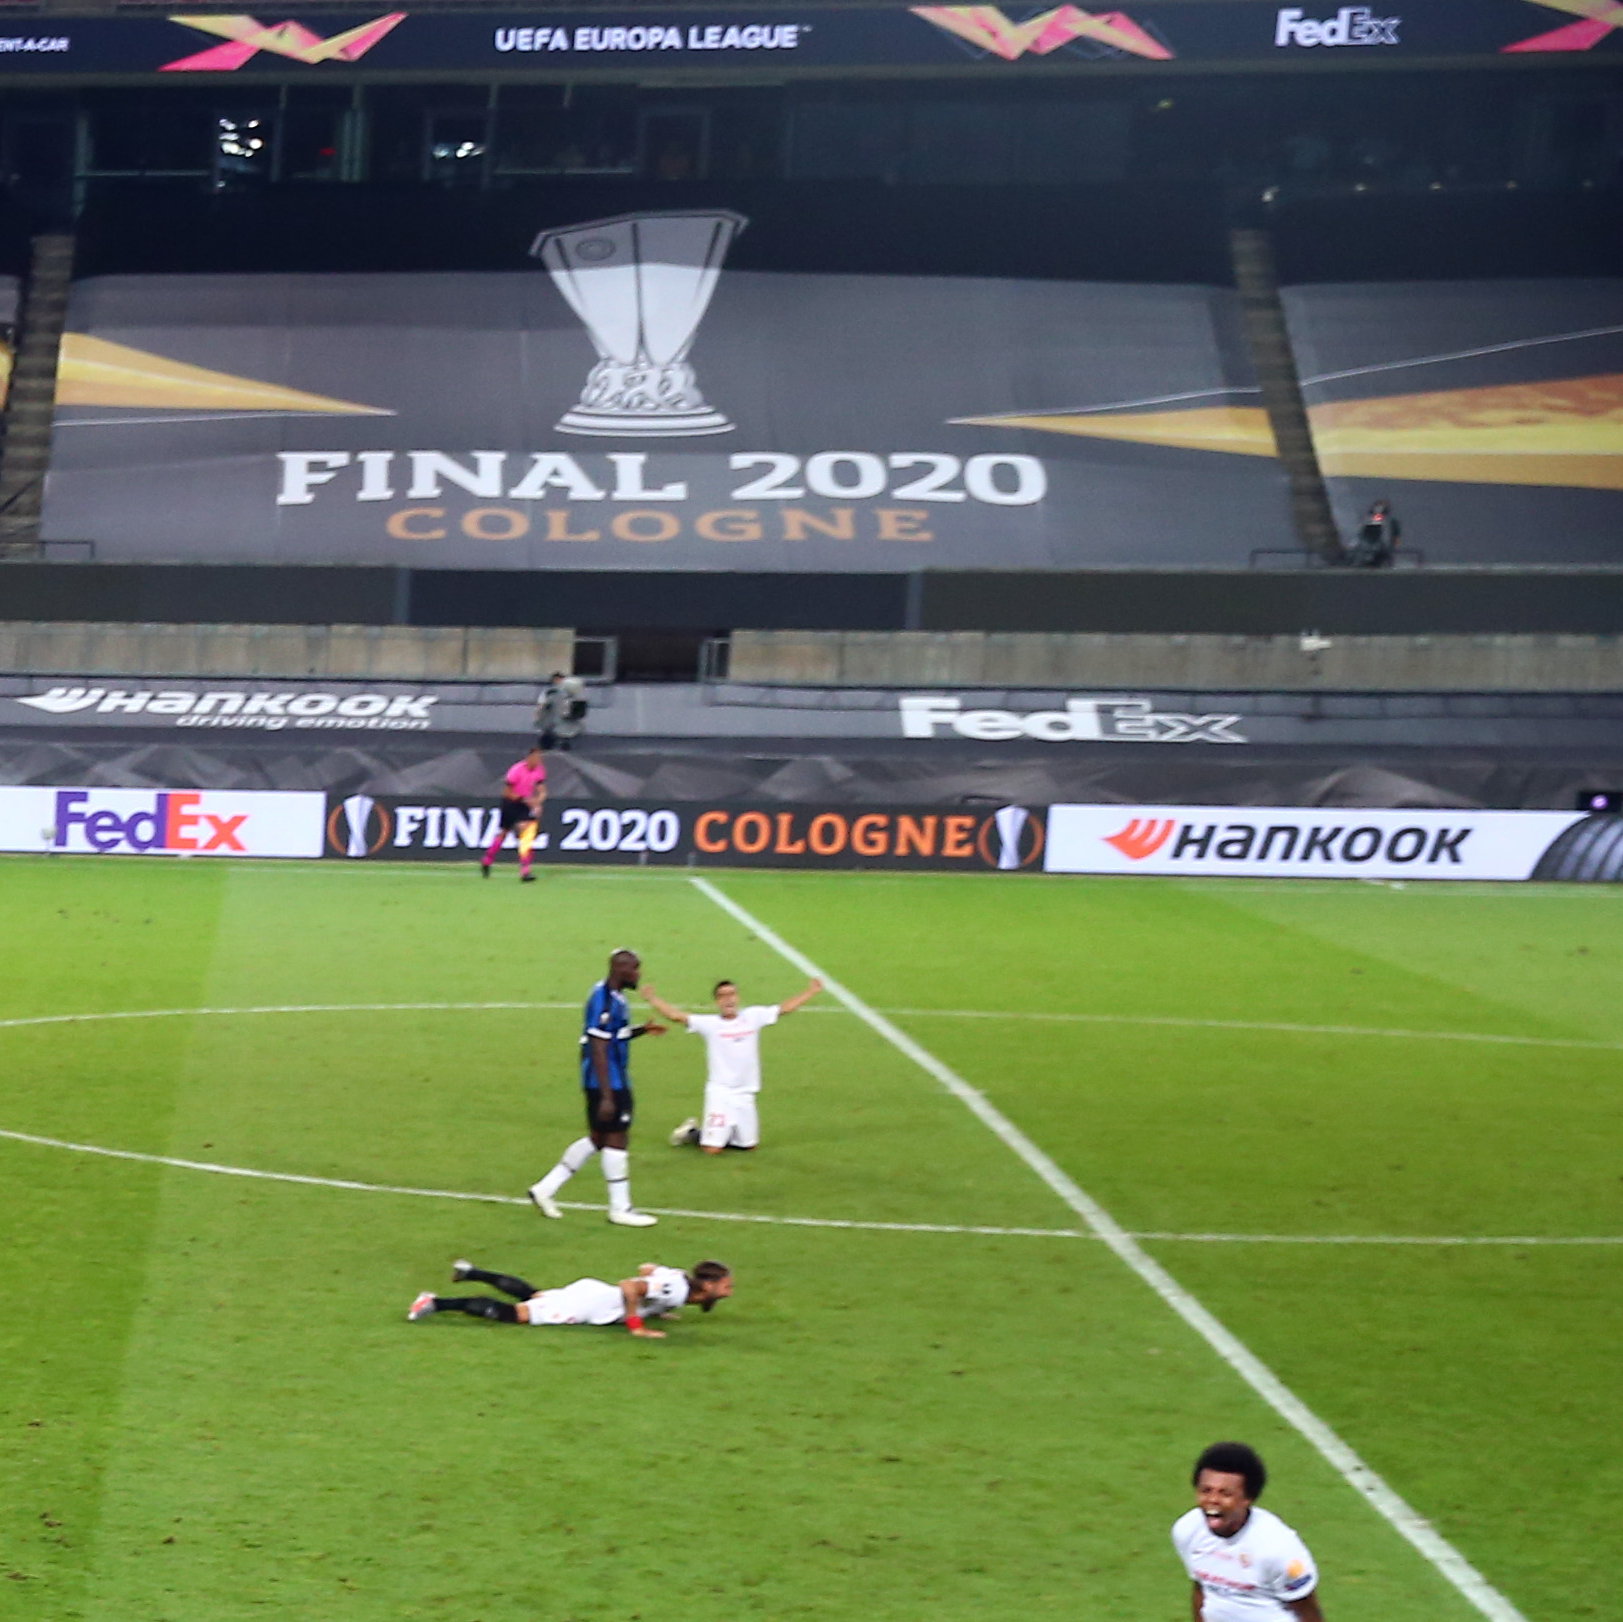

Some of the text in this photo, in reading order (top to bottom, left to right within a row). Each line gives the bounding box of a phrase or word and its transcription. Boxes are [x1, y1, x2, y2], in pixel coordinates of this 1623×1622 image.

[495, 26, 798, 52] UEFA EUROPA LEAGUE
[1275, 9, 1401, 48] FedEx
[276, 450, 1048, 506] FINAL 2020
[385, 507, 935, 542] COLOGNE
[175, 713, 431, 731] driving emotion
[898, 696, 1249, 744] FedEx
[55, 790, 249, 854] FedEx
[559, 809, 681, 853] 2020
[693, 810, 977, 859] COLOGNE
